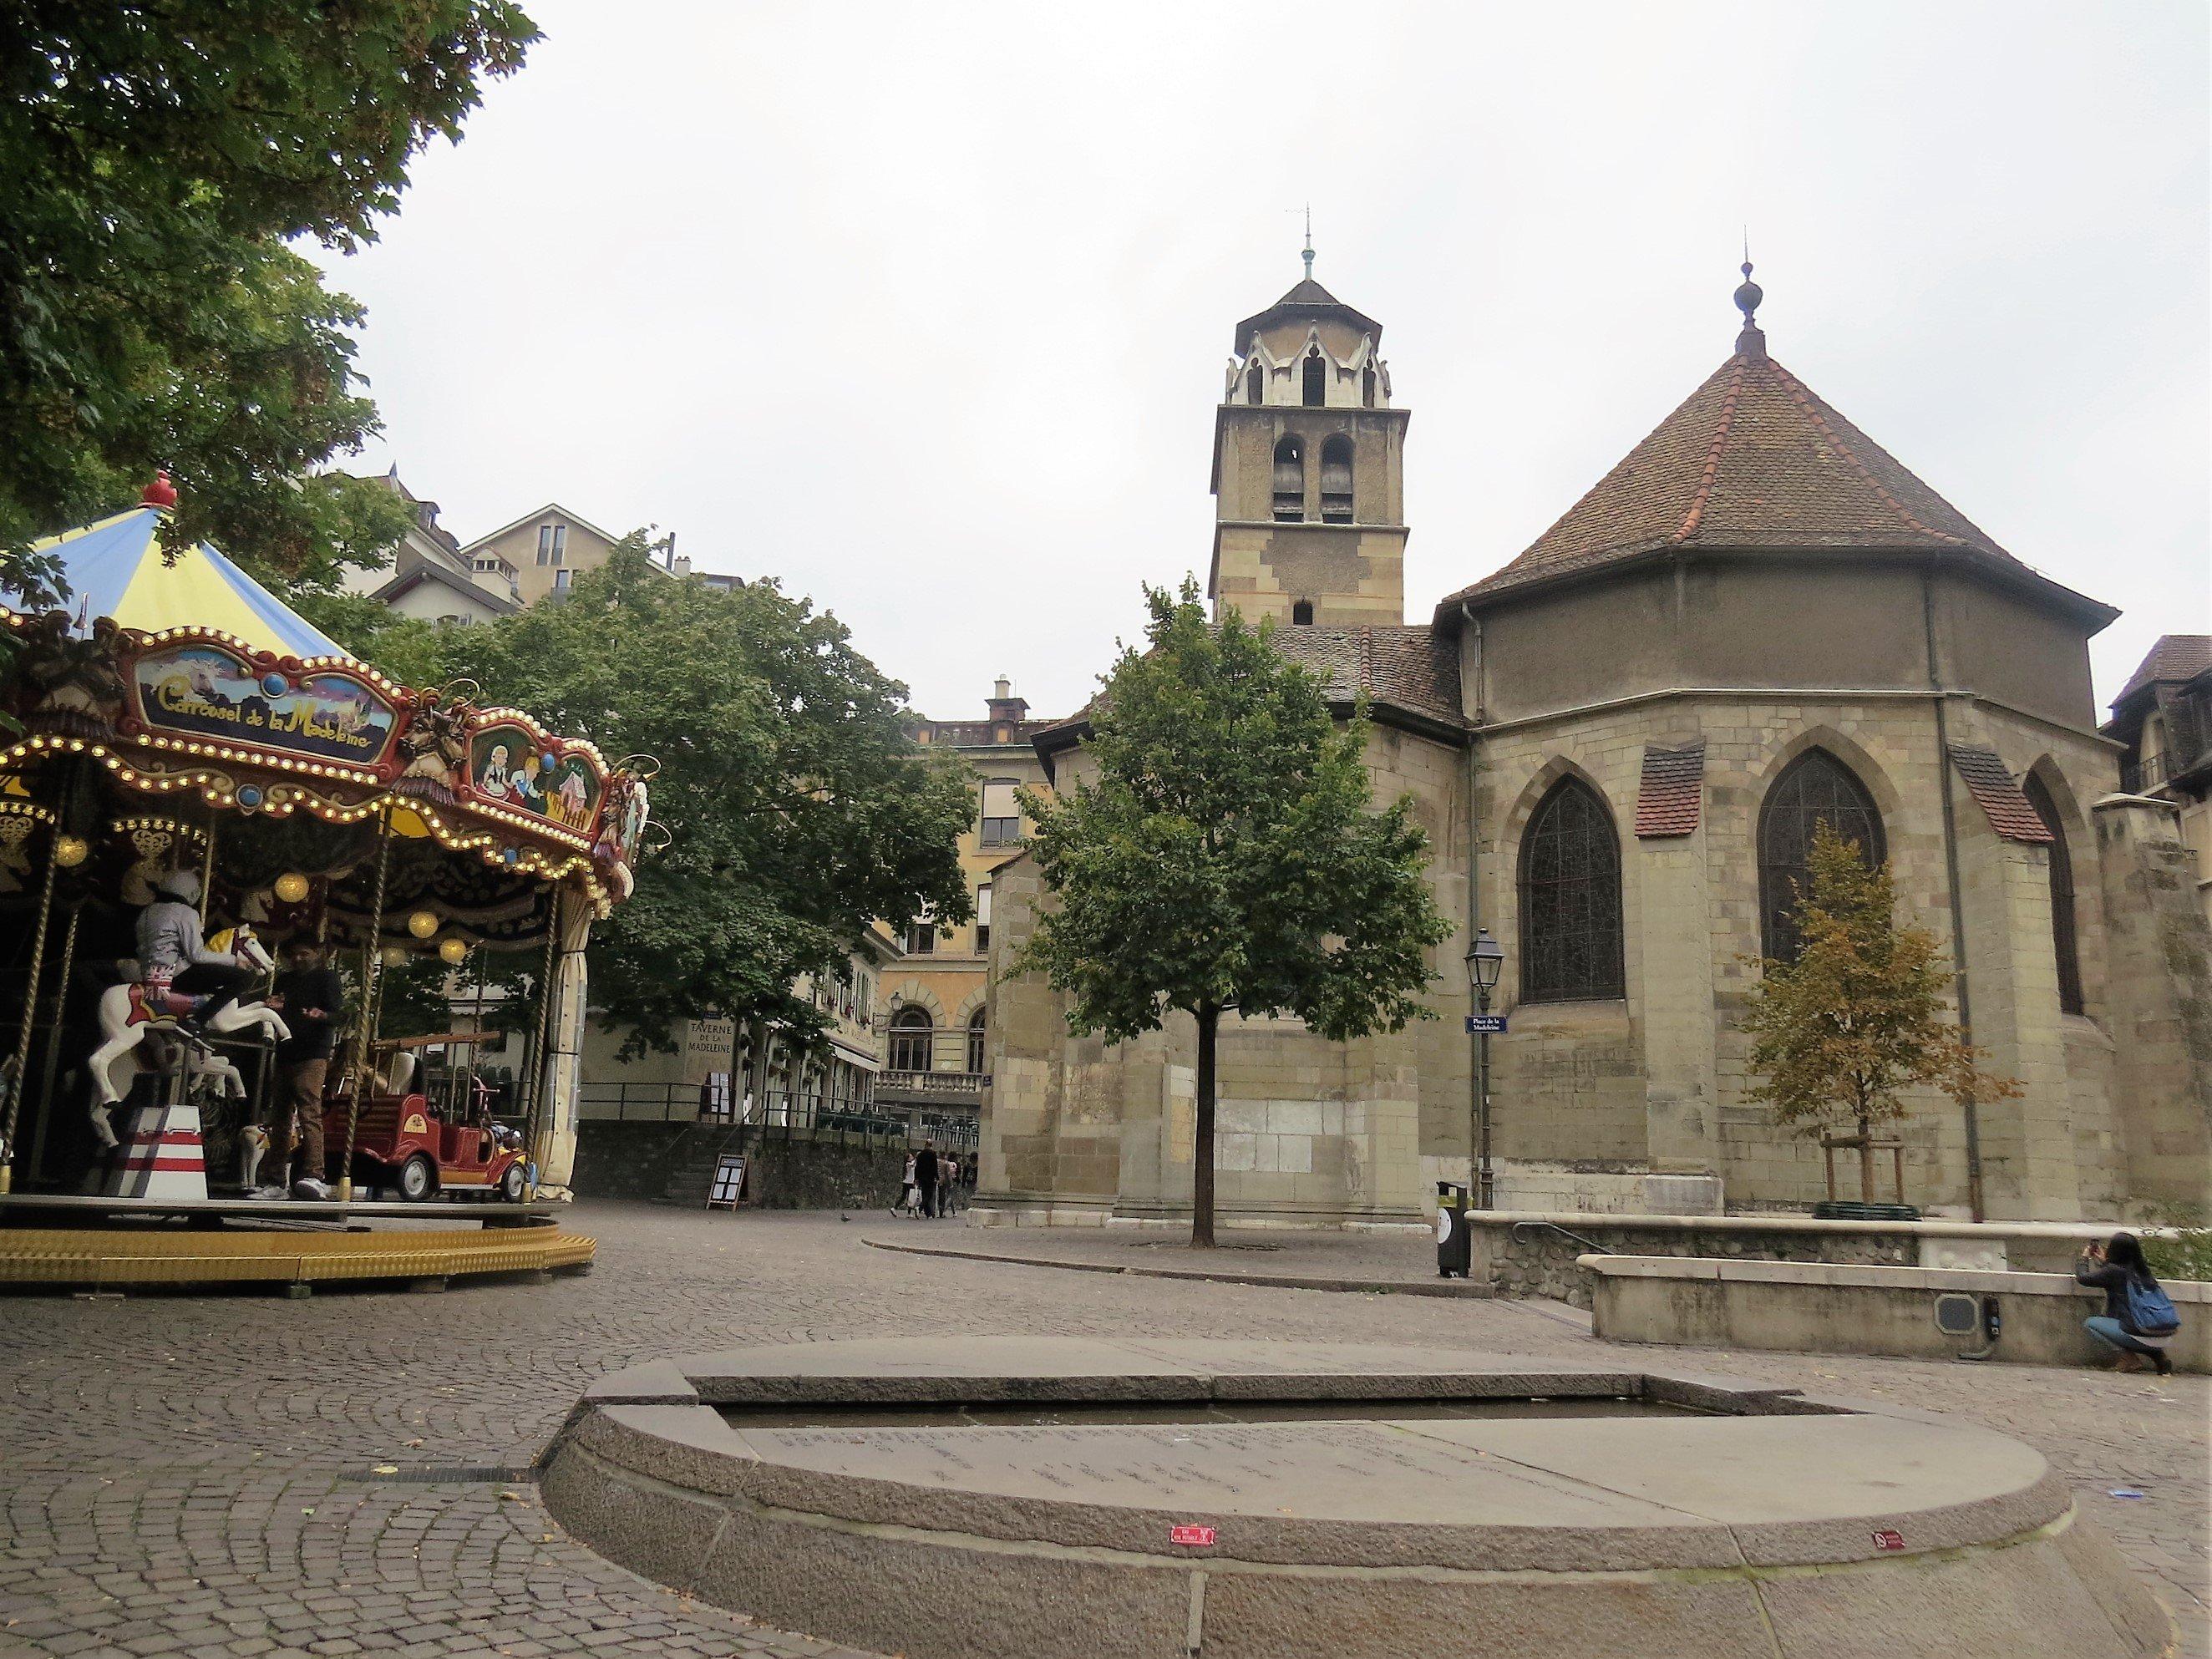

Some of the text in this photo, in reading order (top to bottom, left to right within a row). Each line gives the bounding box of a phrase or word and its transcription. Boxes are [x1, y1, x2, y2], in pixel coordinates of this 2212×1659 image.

[158, 674, 373, 748] Carrousel de la Madeleine
[691, 1023, 732, 1034] TAVERNE
[687, 1043, 731, 1053] MADELEINE
